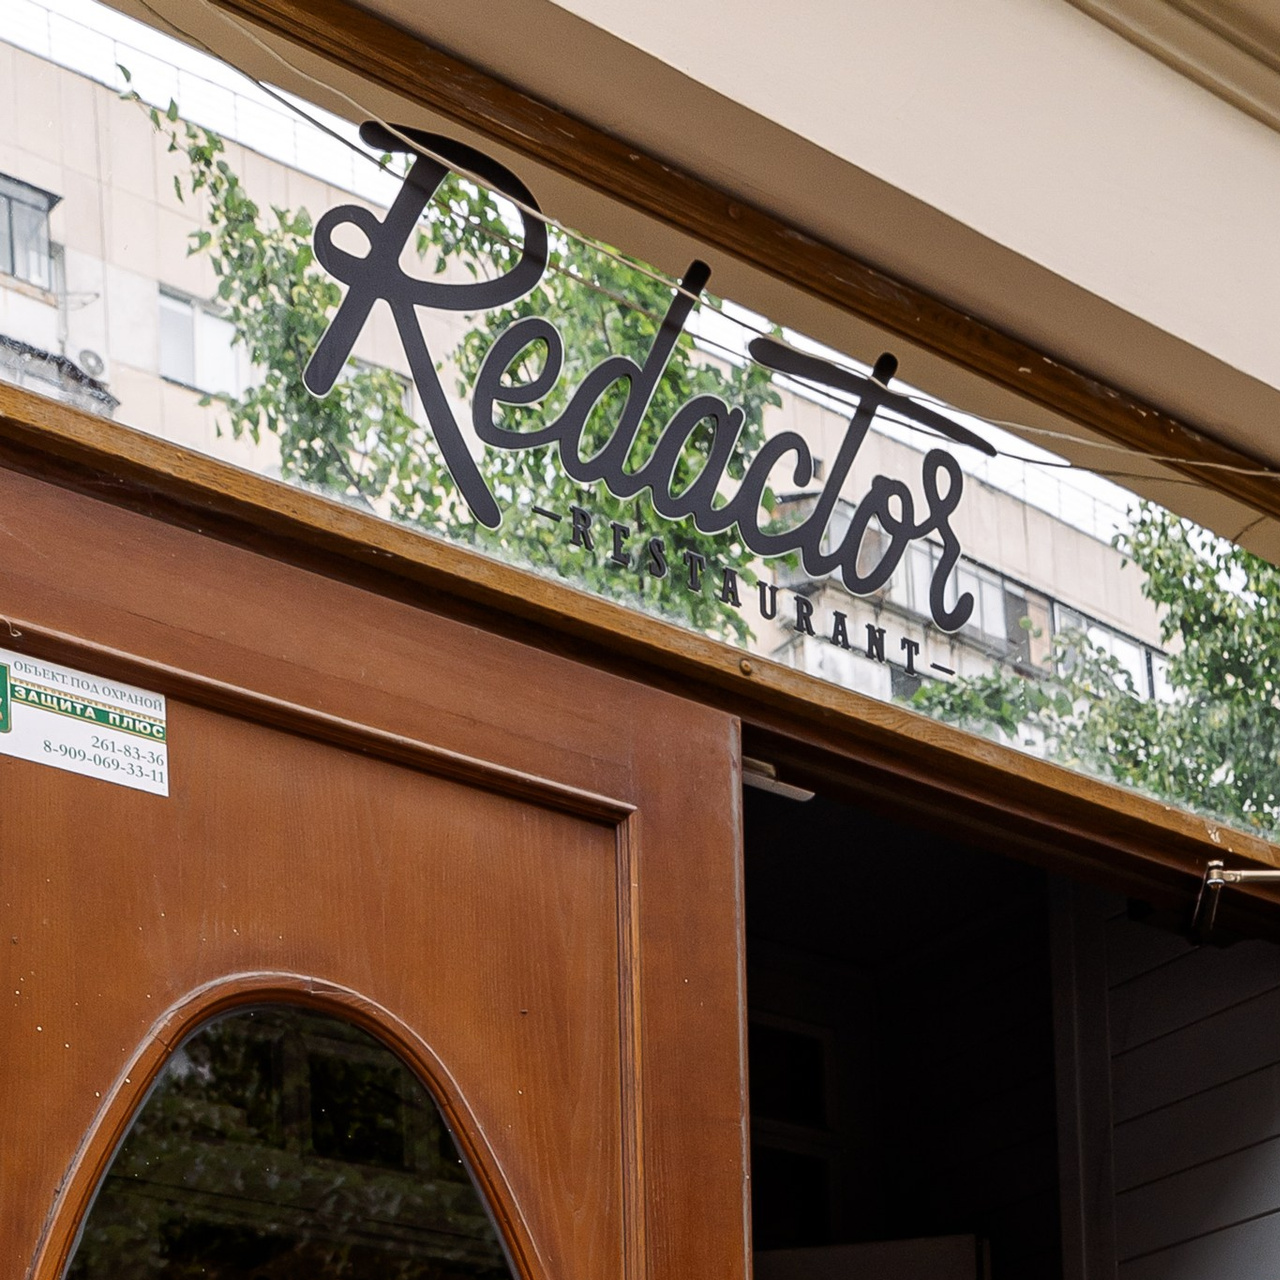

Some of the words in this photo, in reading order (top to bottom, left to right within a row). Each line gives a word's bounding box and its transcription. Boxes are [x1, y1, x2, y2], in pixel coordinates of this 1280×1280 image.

[303, 120, 997, 634] Redactor
[567, 504, 921, 678] RESTAURANT
[13, 660, 68, 685] ОБЪЕКТ
[71, 676, 99, 695] ПОД
[102, 686, 163, 712] ОХРАНОЙ
[14, 686, 96, 719] ЗАЩИТА
[108, 712, 164, 738] ПЛЮС
[43, 739, 165, 784] 8-909-069-33-11
[91, 735, 164, 766] 261-83-36
